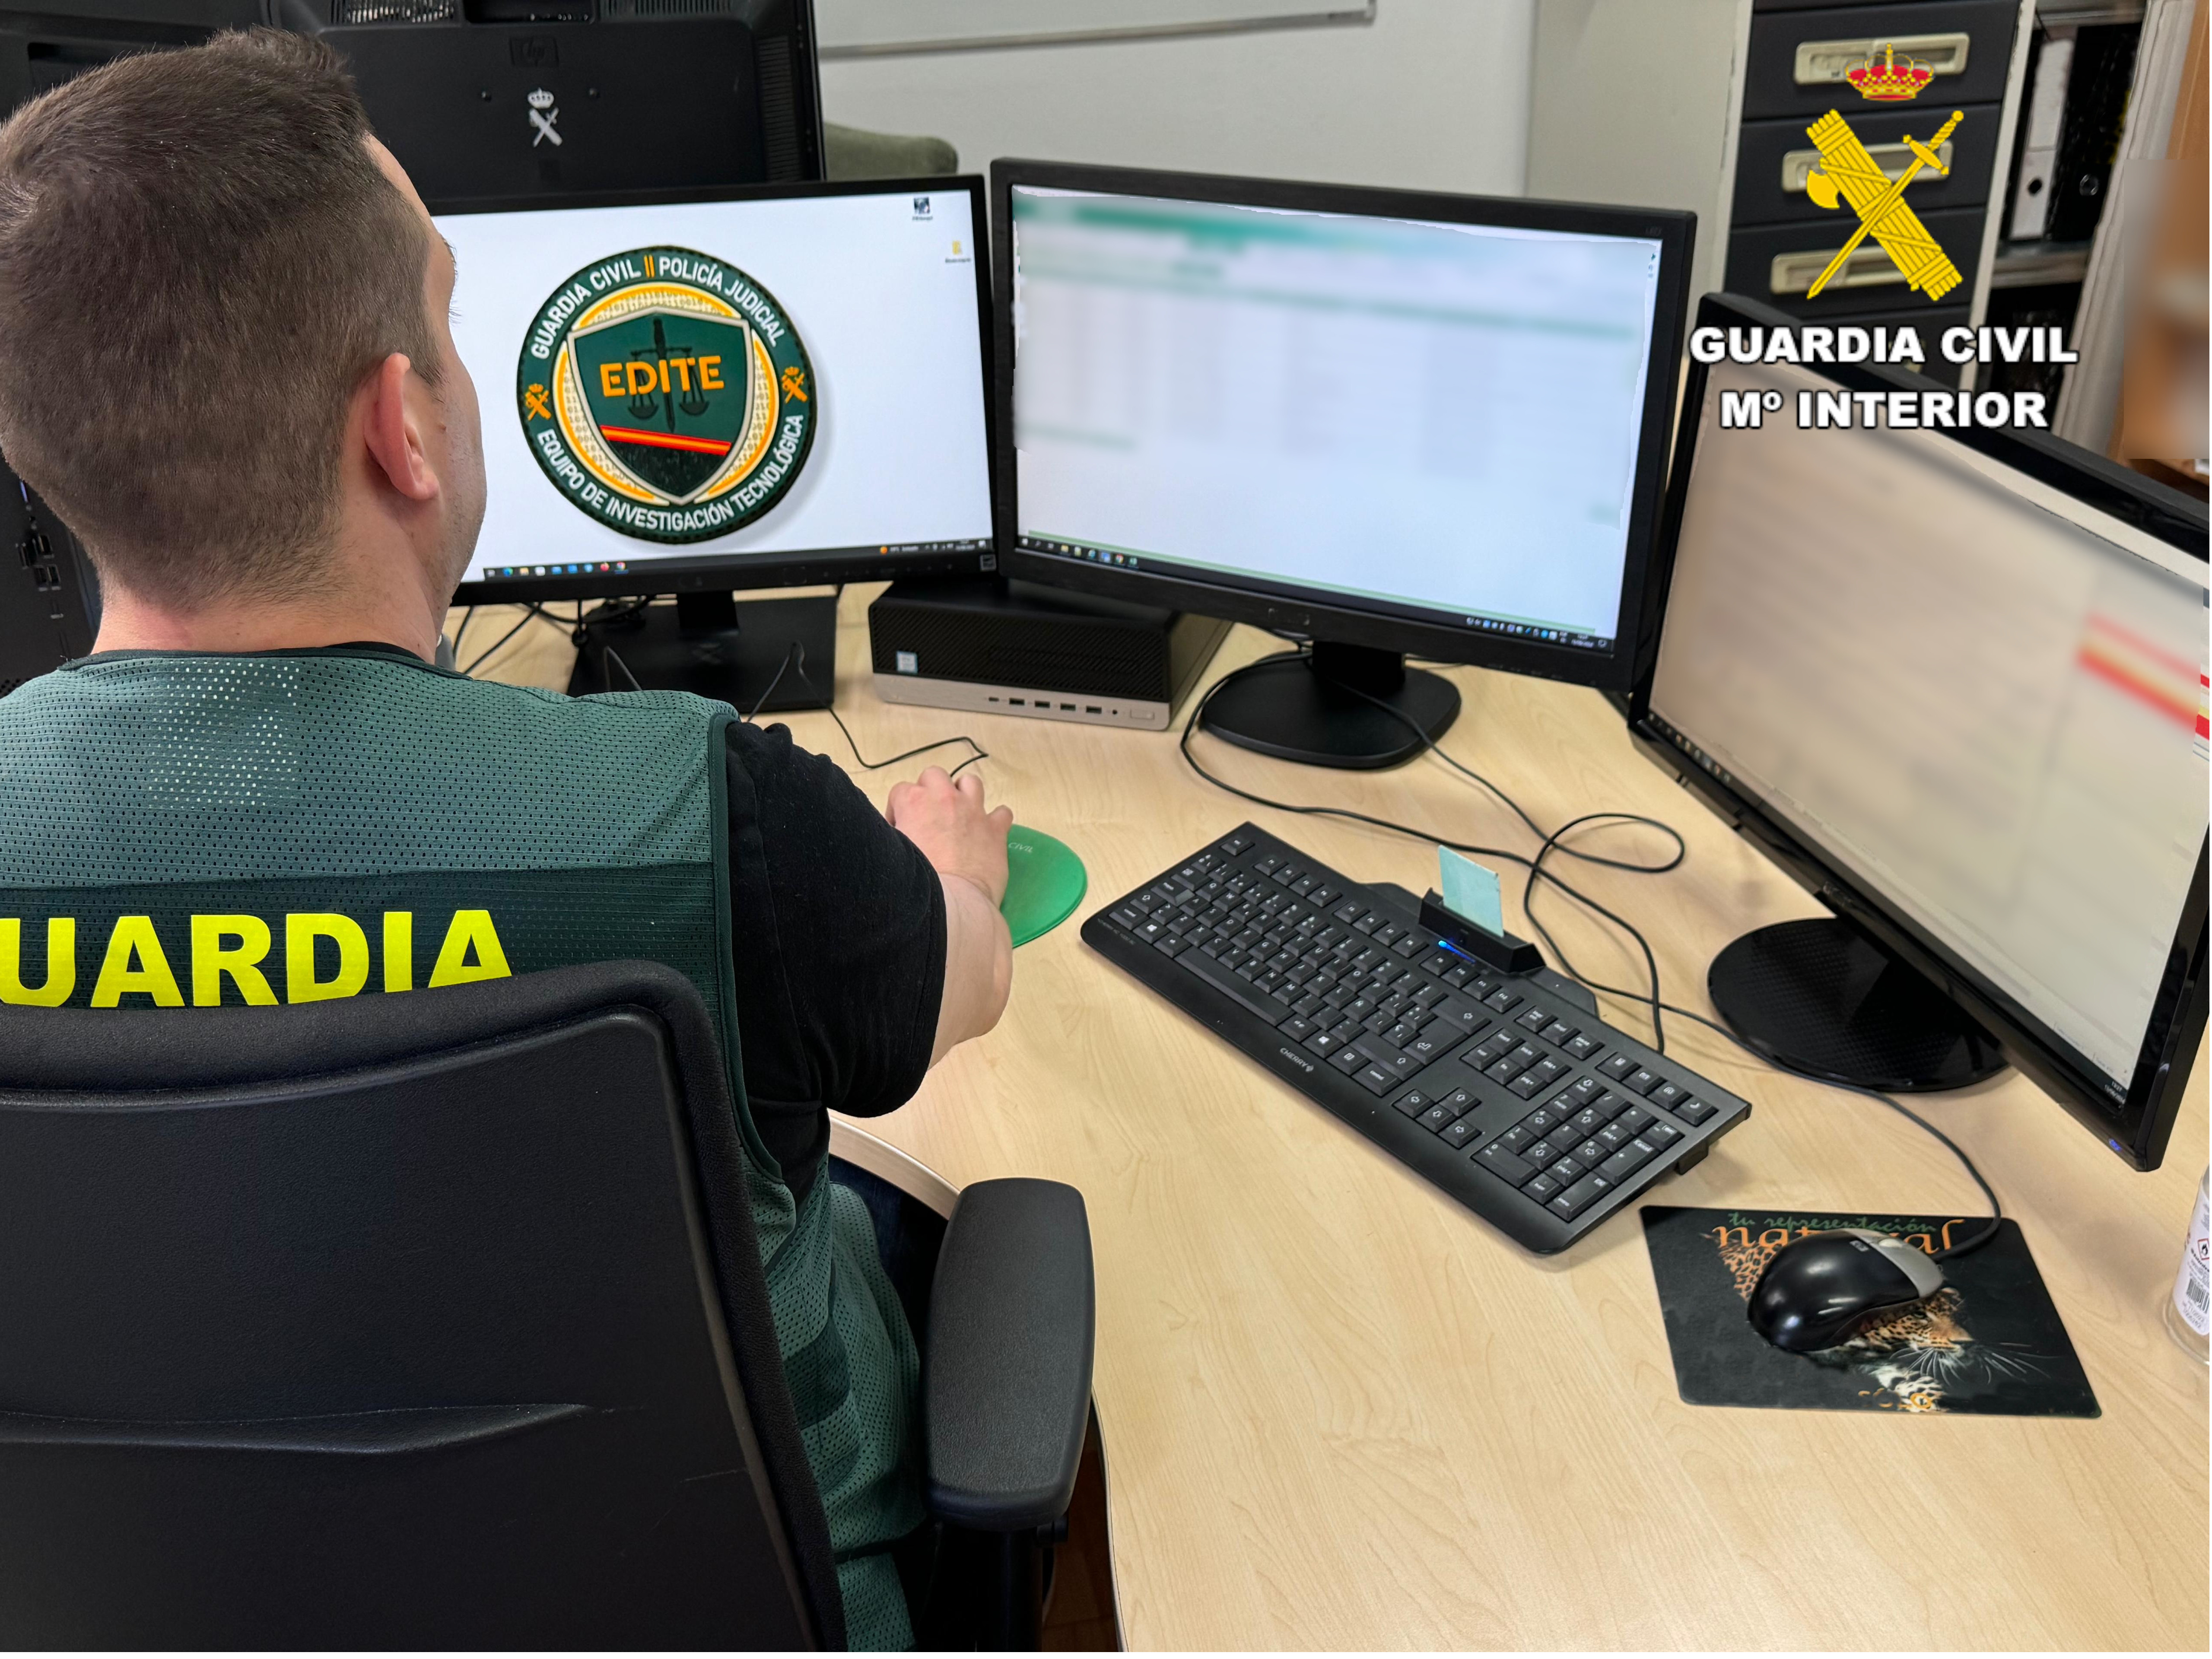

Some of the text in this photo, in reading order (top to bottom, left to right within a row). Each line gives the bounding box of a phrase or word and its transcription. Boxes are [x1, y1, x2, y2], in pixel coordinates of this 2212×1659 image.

[531, 286, 590, 359] GUARDIA
[589, 258, 641, 290] CIVIL
[659, 256, 722, 292] POLICÍA
[726, 281, 785, 346] JUDICIAL
[600, 356, 725, 397] EDITE
[538, 414, 804, 532] EQUIPO DE INVESTIGACIÓN TECNOLÓGICA
[1008, 842, 1033, 854] CIVIL
[1279, 1047, 1308, 1068] CHERRY
[1712, 1219, 1965, 1255] naal
[1728, 1212, 1755, 1226] tu
